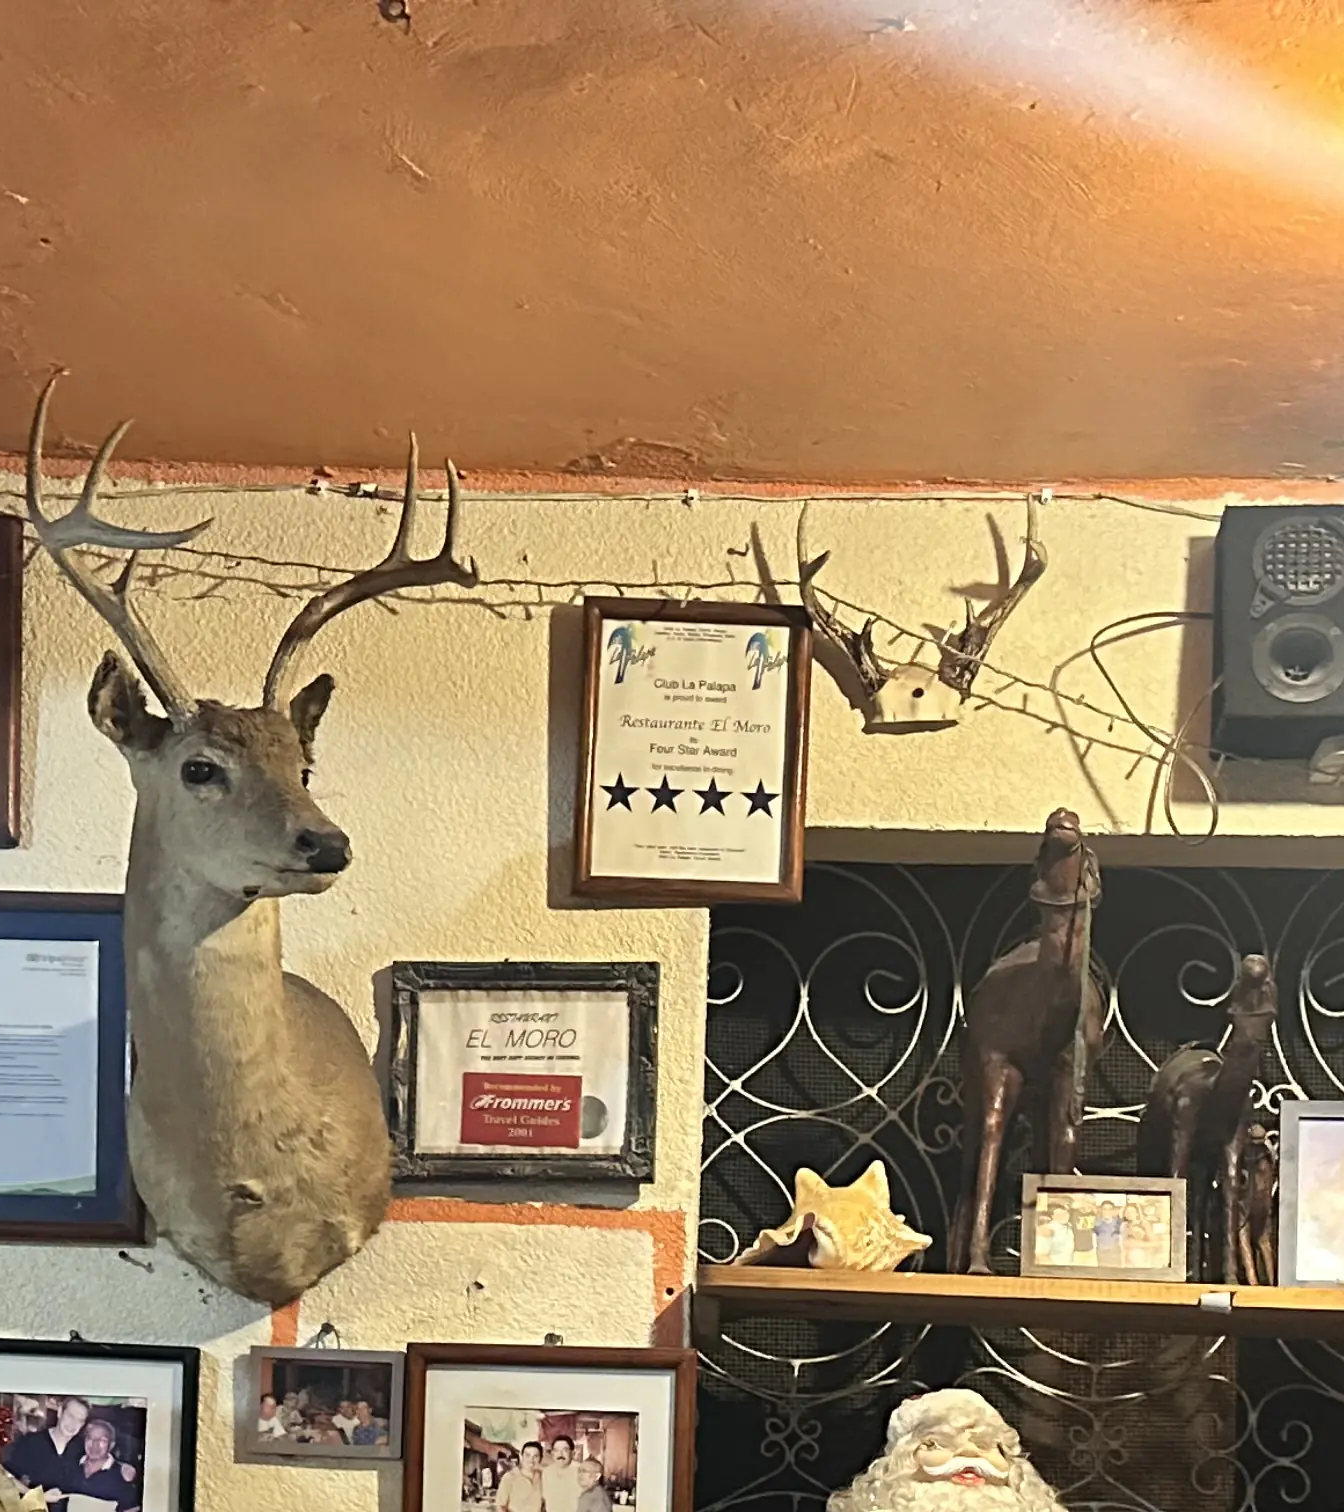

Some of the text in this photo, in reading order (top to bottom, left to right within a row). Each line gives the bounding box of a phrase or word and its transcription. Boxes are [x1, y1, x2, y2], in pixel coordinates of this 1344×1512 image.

[654, 678, 736, 693] Club La Palapa
[620, 714, 771, 734] Restaurante El Moro
[649, 743, 738, 758] Four Star Award
[466, 1028, 577, 1049] EL MORO
[474, 1094, 573, 1112] Frommer's
[483, 1113, 560, 1126] Travel Guides
